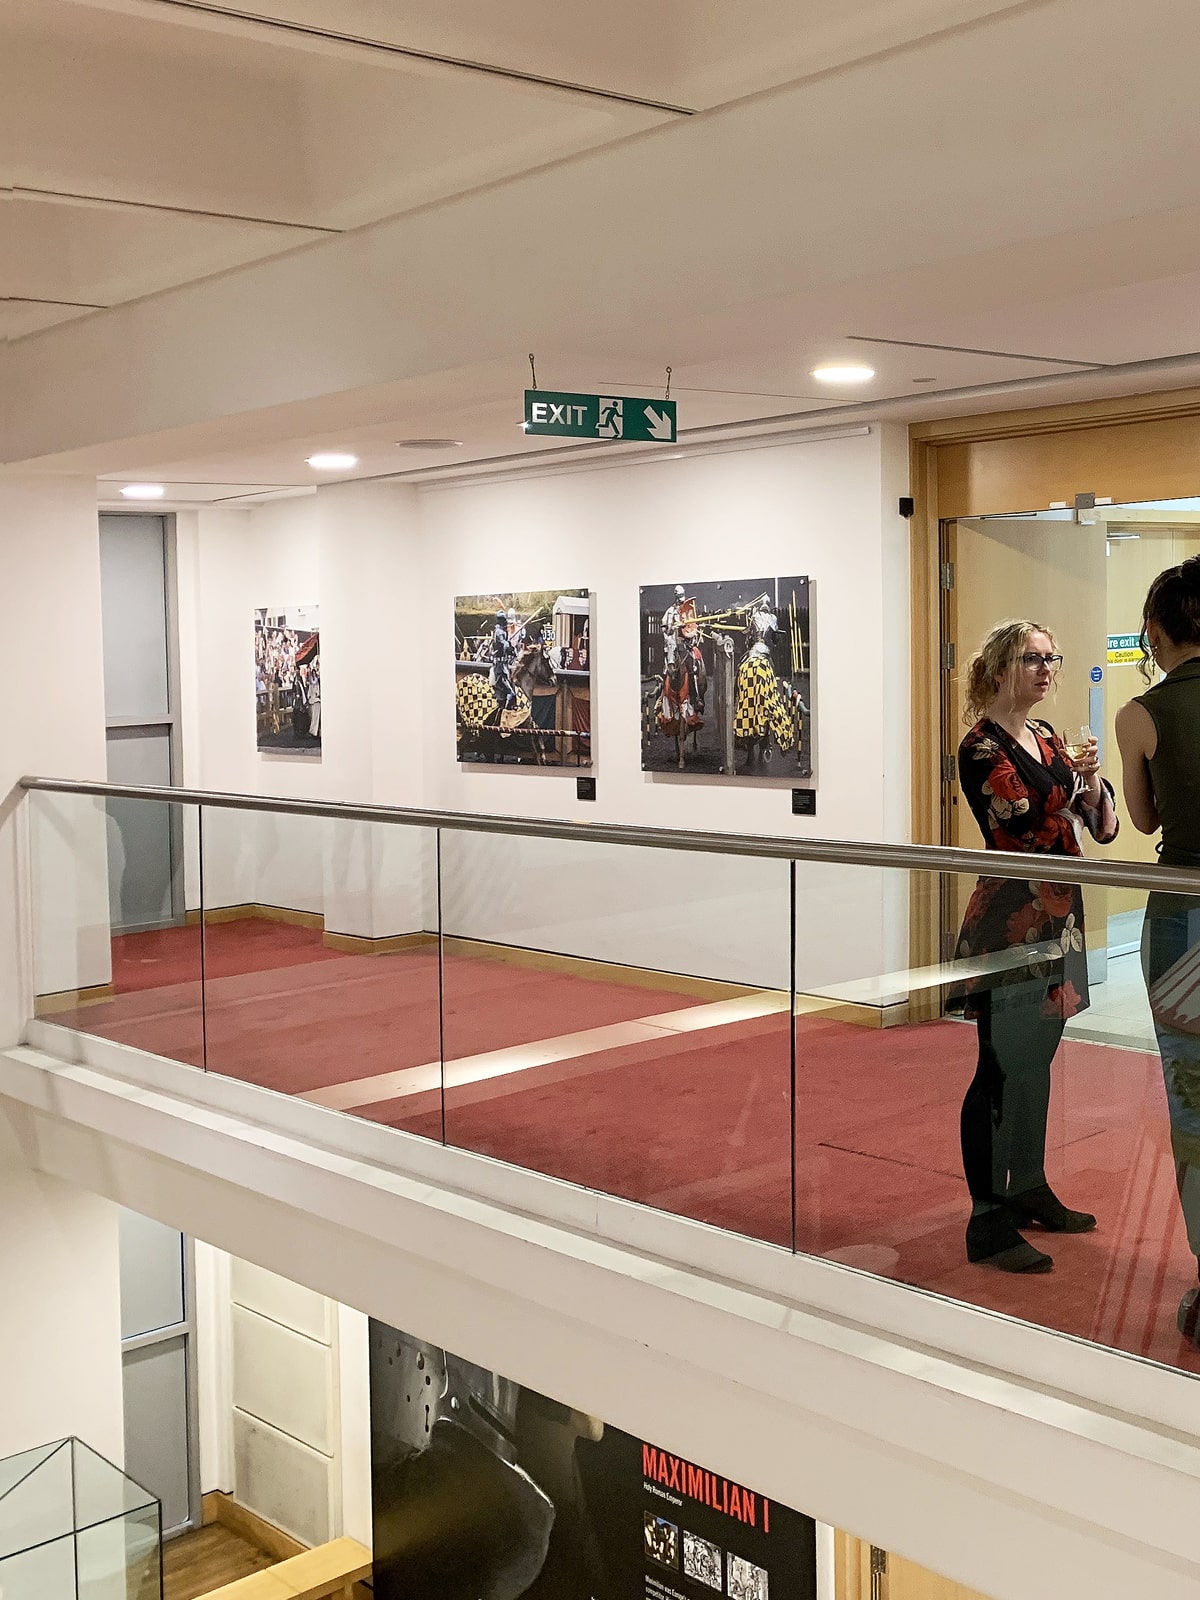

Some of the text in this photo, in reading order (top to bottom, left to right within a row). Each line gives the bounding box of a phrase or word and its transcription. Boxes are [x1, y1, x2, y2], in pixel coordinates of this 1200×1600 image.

[531, 402, 588, 426] EXIT
[1107, 638, 1118, 648] ire
[1119, 637, 1135, 647] exit
[642, 1444, 769, 1533] MAXIMILIAN I
